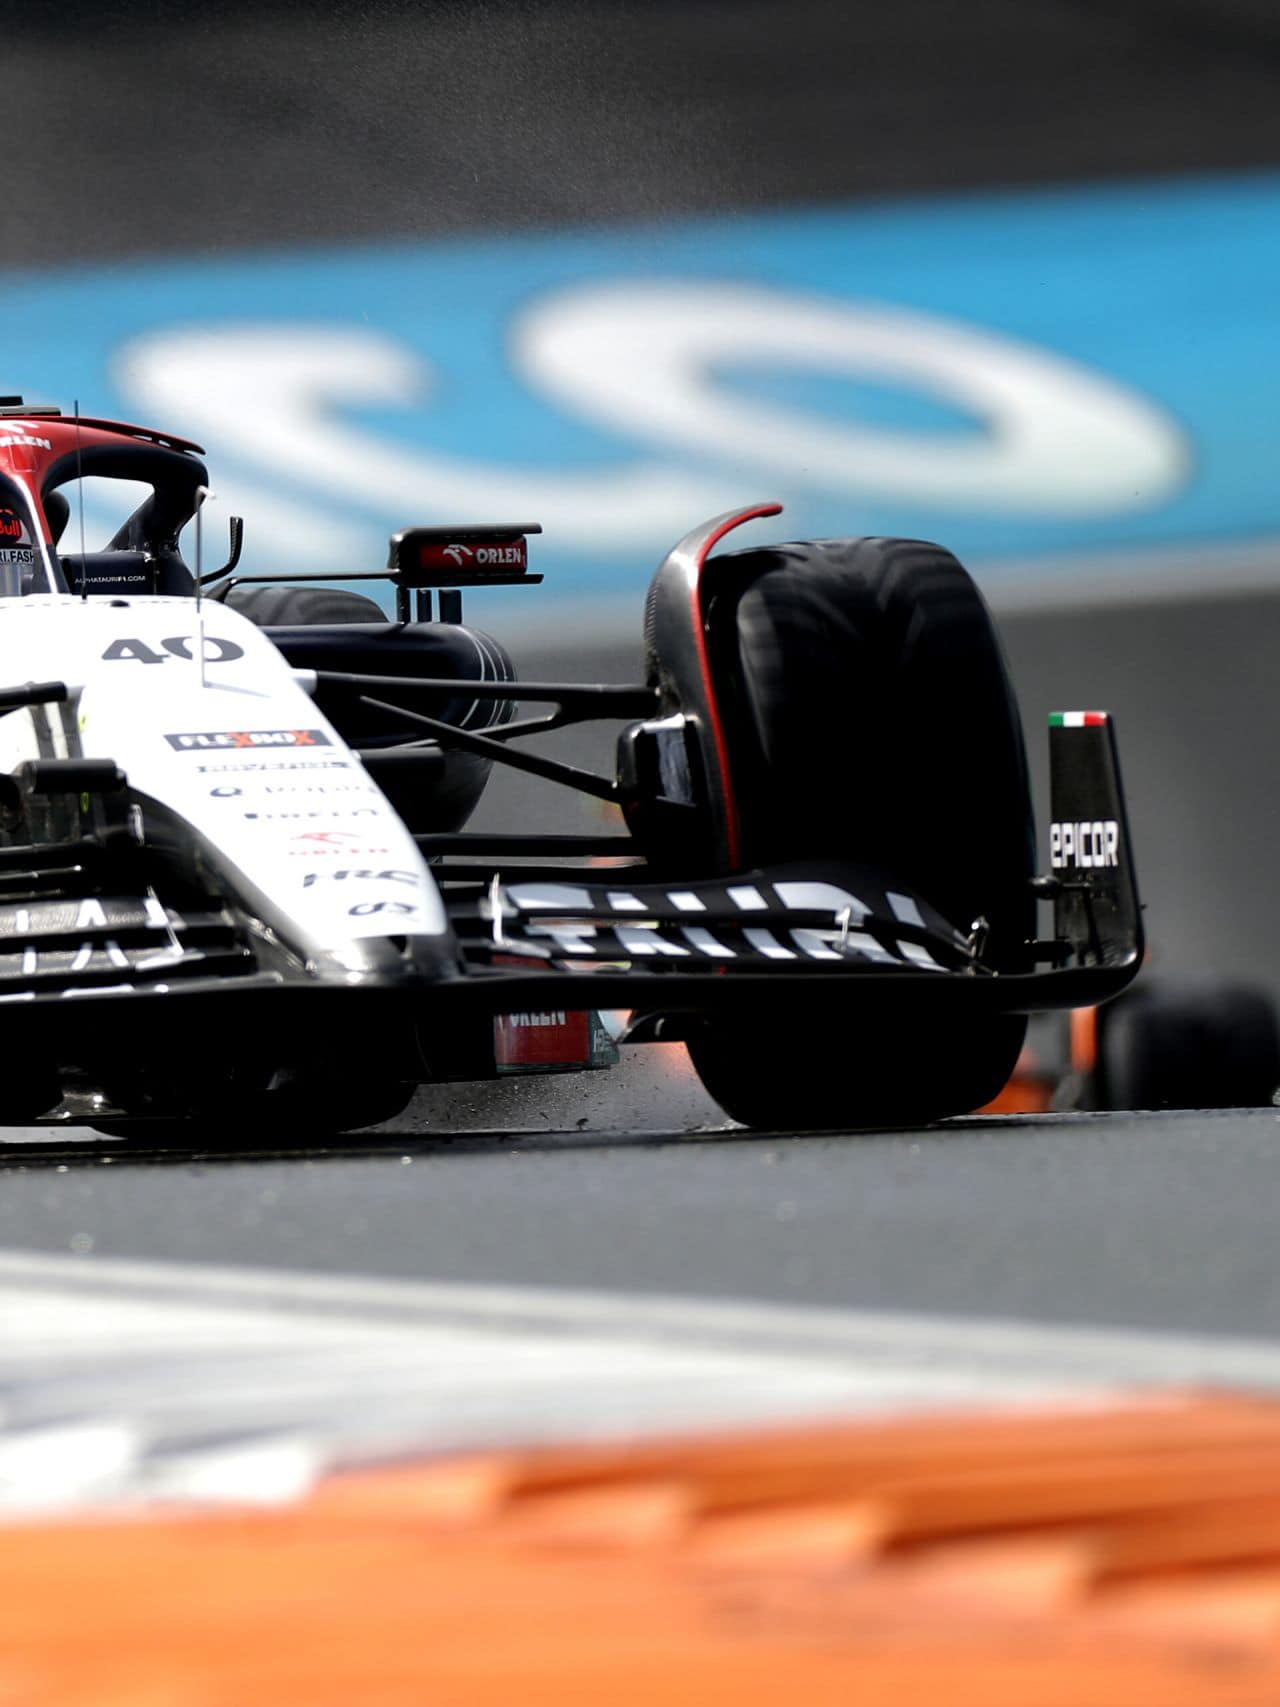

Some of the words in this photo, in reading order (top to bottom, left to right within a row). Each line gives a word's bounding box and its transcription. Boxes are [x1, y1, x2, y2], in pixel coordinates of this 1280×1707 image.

[476, 548, 521, 564] ORLEN
[101, 636, 245, 664] 40
[177, 730, 316, 748] FLEXBOX
